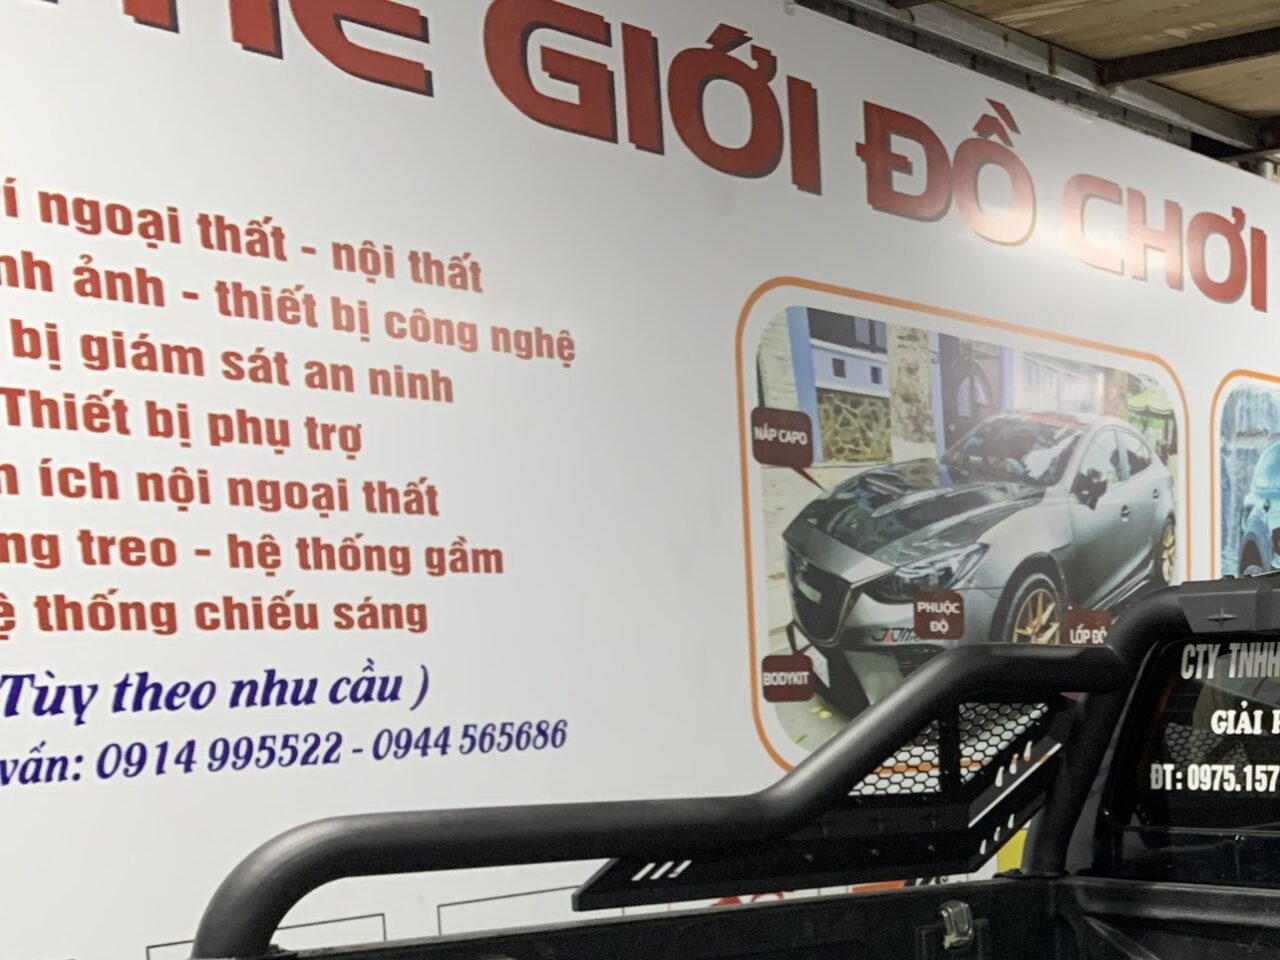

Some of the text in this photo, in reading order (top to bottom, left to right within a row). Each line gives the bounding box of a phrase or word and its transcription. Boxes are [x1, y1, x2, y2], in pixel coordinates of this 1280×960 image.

[483, 0, 822, 196] GIỚI
[855, 98, 1037, 248] ĐỒ
[1062, 173, 1267, 313] CHƠI
[38, 191, 181, 249] ngoại
[197, 212, 287, 262] thất
[331, 239, 395, 284] nội
[408, 252, 484, 293] thất
[72, 253, 165, 306] ảnh
[215, 280, 318, 328] thiết
[330, 296, 370, 342] bị
[384, 308, 478, 353] công
[490, 325, 576, 368] nghệ
[10, 318, 454, 403] bị giám sát an ninh
[0, 386, 362, 460] Thiết bị phụ trợ
[778, 429, 808, 446] CAPO
[39, 458, 119, 500] ích
[137, 466, 211, 512] nội
[227, 477, 349, 518] ngoại
[362, 477, 439, 516] thất
[78, 529, 177, 567] treo
[227, 533, 282, 577] hệ
[296, 532, 411, 576] thống
[425, 535, 504, 577] gầm
[34, 588, 178, 635] thống
[194, 589, 319, 632] chiếu
[333, 596, 429, 633] sáng
[0, 670, 98, 726] Tùy
[112, 671, 217, 713] theo
[229, 669, 318, 709] nhu
[328, 658, 404, 705] cầu
[763, 671, 810, 686] BODYKIT
[1180, 643, 1221, 680] CTY
[1210, 700, 1264, 735] GIẢI
[0, 740, 83, 787] vấn:
[96, 740, 197, 780] 0914
[207, 731, 343, 772] 995522
[372, 725, 451, 760] 0944
[458, 719, 568, 756] 565686
